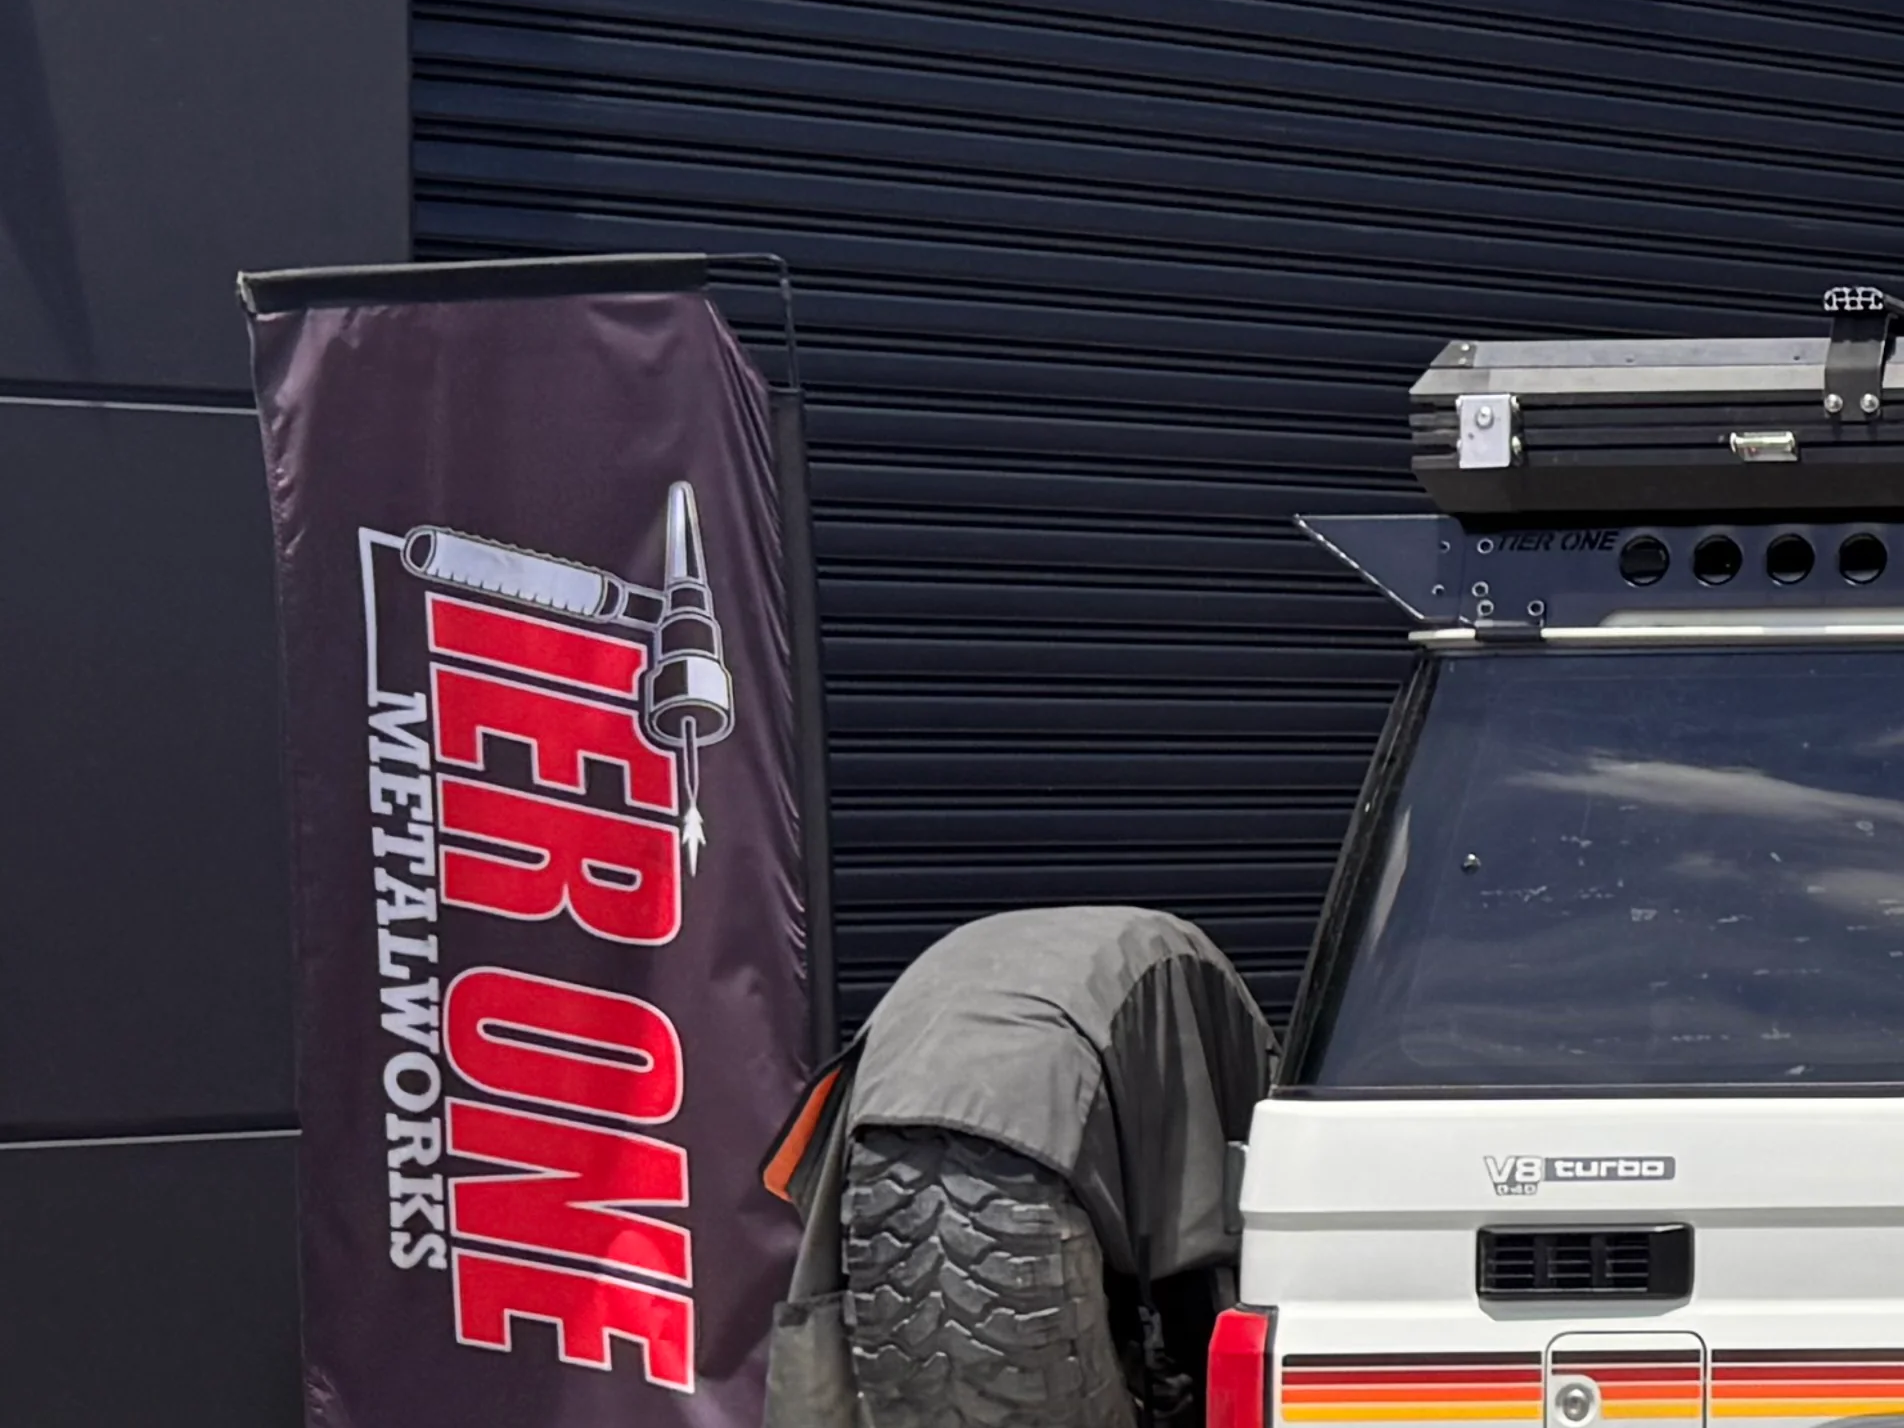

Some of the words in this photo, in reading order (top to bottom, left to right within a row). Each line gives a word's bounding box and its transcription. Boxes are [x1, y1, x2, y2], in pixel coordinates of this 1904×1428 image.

[1560, 529, 1620, 552] ONE
[368, 692, 447, 1271] METALWORKS
[443, 965, 695, 1394] ONE
[1484, 1155, 1544, 1183] V8
[1553, 1159, 1666, 1178] turbo
